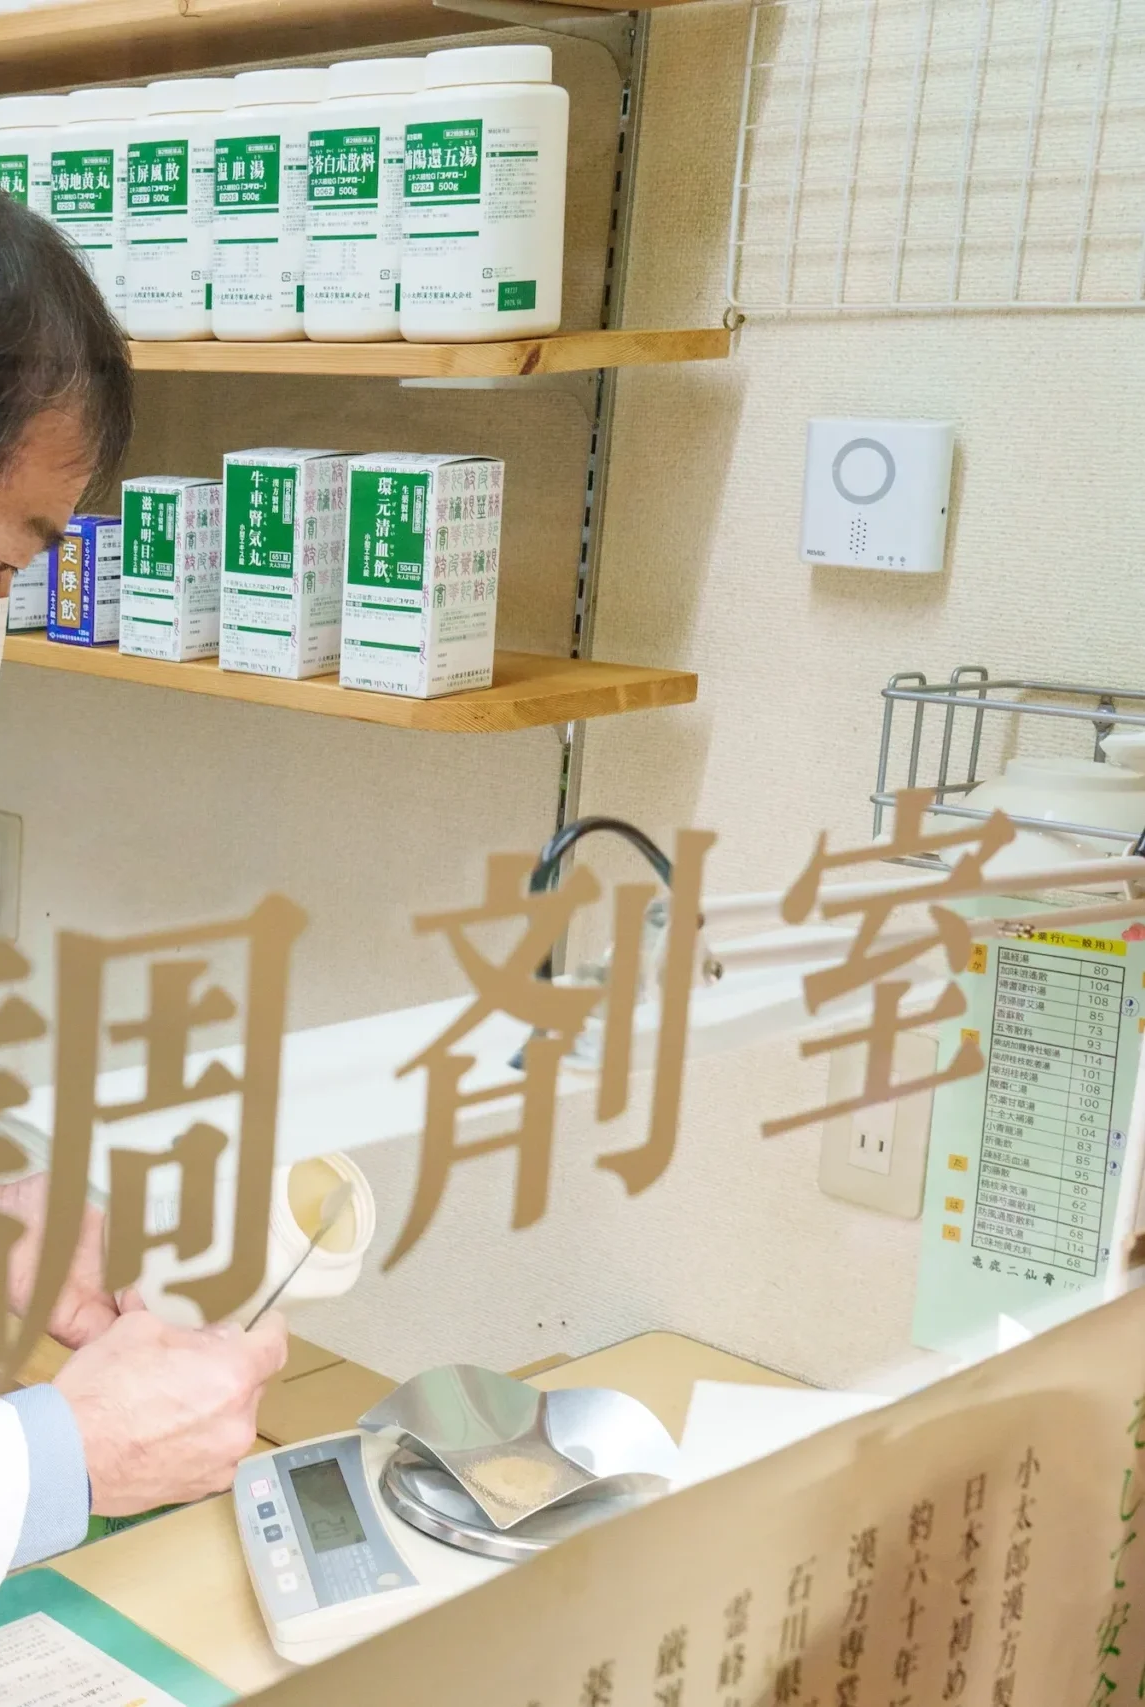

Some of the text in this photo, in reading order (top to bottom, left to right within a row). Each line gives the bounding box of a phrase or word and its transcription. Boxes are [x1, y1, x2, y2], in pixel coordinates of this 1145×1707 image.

[338, 186, 358, 196] 500g
[438, 182, 459, 192] 500g
[152, 193, 170, 203] 500g
[242, 193, 260, 202] 500g
[1093, 966, 1109, 977] 80
[1090, 980, 1110, 992] 104
[1088, 995, 1109, 1007] 108
[1089, 1011, 1104, 1022] 85
[1088, 1025, 1103, 1036] 73
[1087, 1039, 1102, 1050] 93
[1083, 1054, 1102, 1066] 114
[1082, 1068, 1101, 1081] 101
[1080, 1083, 1101, 1095] 108
[1079, 1097, 1100, 1109] 100
[1079, 1112, 1095, 1123] 64
[1076, 1126, 1096, 1138] 104
[1076, 1141, 1092, 1152] 83
[1075, 1155, 1091, 1166] 85
[1074, 1170, 1089, 1182] 95
[1072, 1185, 1088, 1196] 80
[1071, 1200, 1087, 1211] 62
[1071, 1214, 1084, 1225] 81
[1069, 1229, 1084, 1240] 68
[1066, 1241, 1084, 1254] 114
[1066, 1257, 1081, 1269] 68
